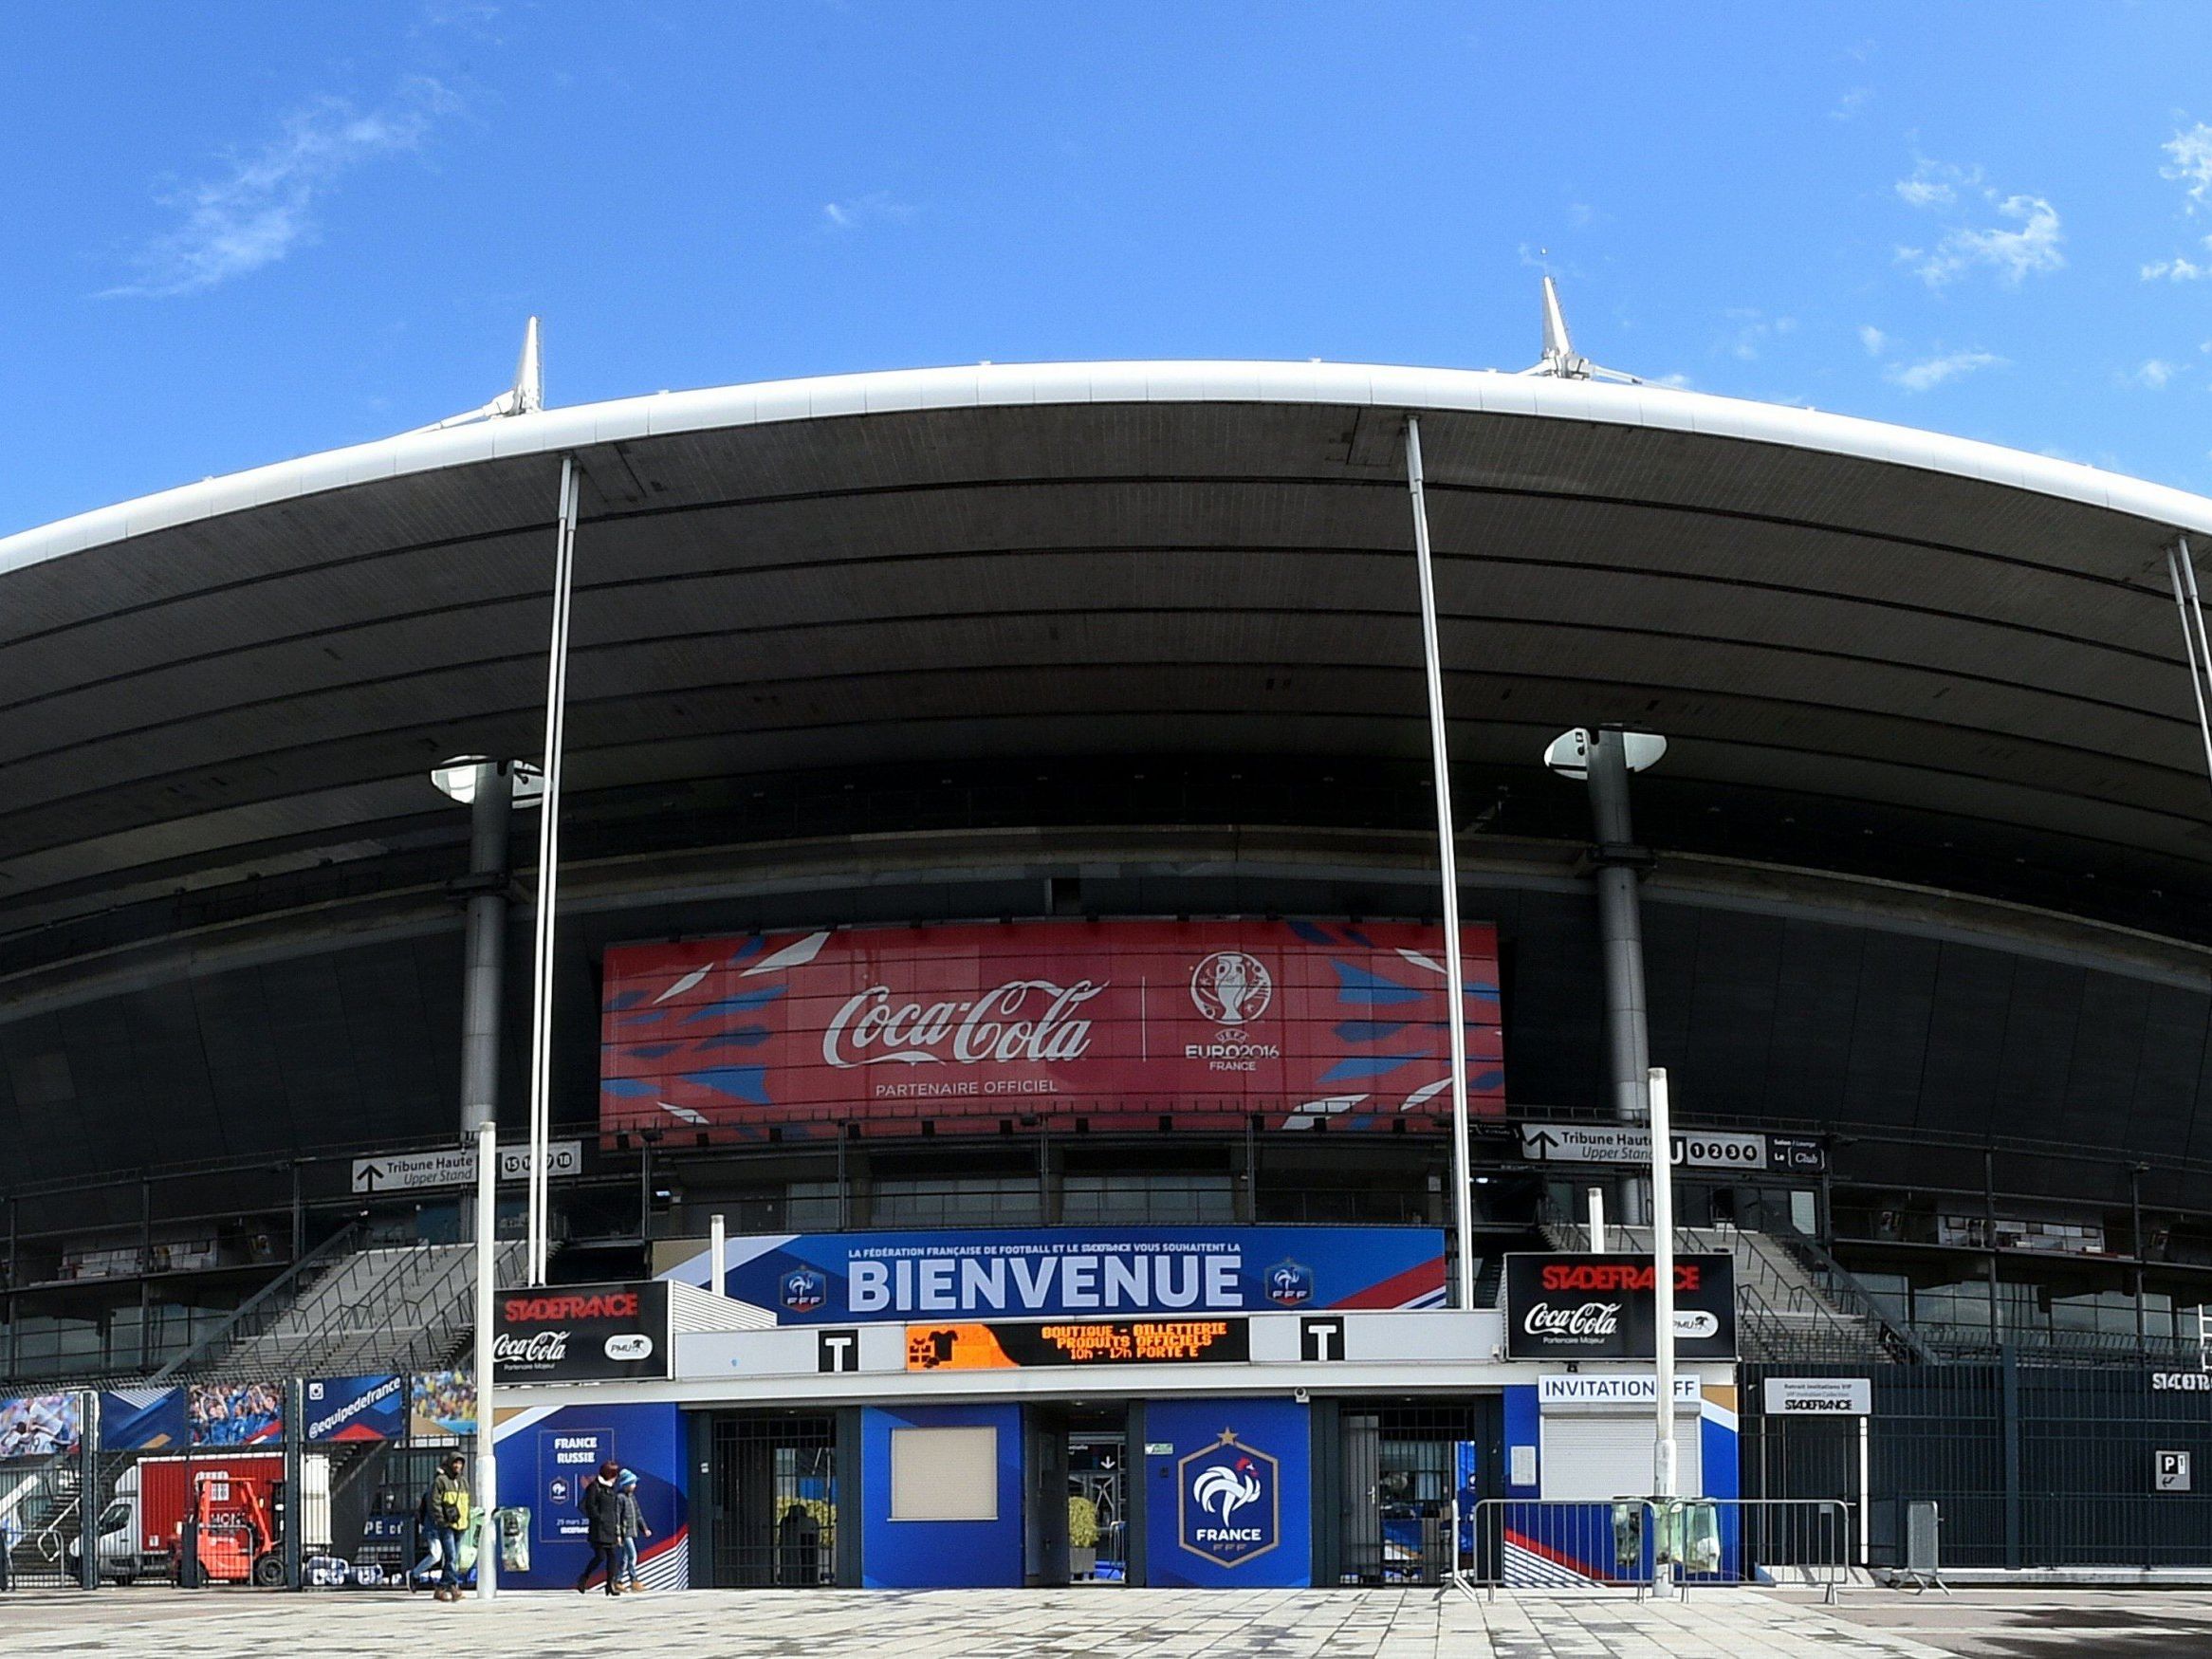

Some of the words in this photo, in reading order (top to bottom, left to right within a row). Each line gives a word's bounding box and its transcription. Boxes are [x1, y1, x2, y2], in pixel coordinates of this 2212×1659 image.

[822, 980, 1110, 1068] Coca-Cola
[1209, 1060, 1257, 1071] FRANCE
[876, 1081, 978, 1097] PARTENAIRE
[984, 1078, 1058, 1094] OFFICIEL
[1561, 1131, 1613, 1146] Tribune
[507, 1158, 519, 1170] 15
[559, 1154, 570, 1166] 18
[1582, 1148, 1619, 1161] Upper
[387, 1160, 433, 1174] Tribune
[435, 1156, 473, 1170] Haute
[404, 1172, 438, 1186] Upper
[439, 1168, 473, 1182] Stand
[849, 1249, 861, 1259] LA
[863, 1246, 925, 1258] FÉDÉRATION
[927, 1246, 982, 1258] FRANÇAISE
[984, 1245, 997, 1255] DE
[999, 1244, 1050, 1255] FOOTBALL
[1052, 1244, 1064, 1253] ET
[1066, 1244, 1079, 1253] LE
[1134, 1243, 1161, 1252] VOUS
[1162, 1243, 1225, 1252] SOUHAITENT
[1227, 1243, 1242, 1252] LA
[849, 1255, 1243, 1313] BIENVENUE
[1542, 1264, 1700, 1291] STADEFRACE
[1524, 1301, 1622, 1335] Coca-Cola
[1041, 1325, 1115, 1339] BOUTIQUE
[1133, 1322, 1227, 1337] BILLETTERIE
[1057, 1335, 1131, 1350] PRODUITS
[1136, 1334, 1212, 1349] OFFICIELS
[1308, 1324, 1336, 1361] T
[825, 1336, 852, 1373] T
[1071, 1348, 1094, 1360] 10h
[1136, 1346, 1189, 1358] PORTE
[1189, 1344, 1199, 1357] E
[308, 1375, 401, 1439] @equipedefrance
[554, 1436, 598, 1449] FRANCE
[557, 1451, 596, 1464] RUSSIE
[1196, 1528, 1262, 1541] FRANCE
